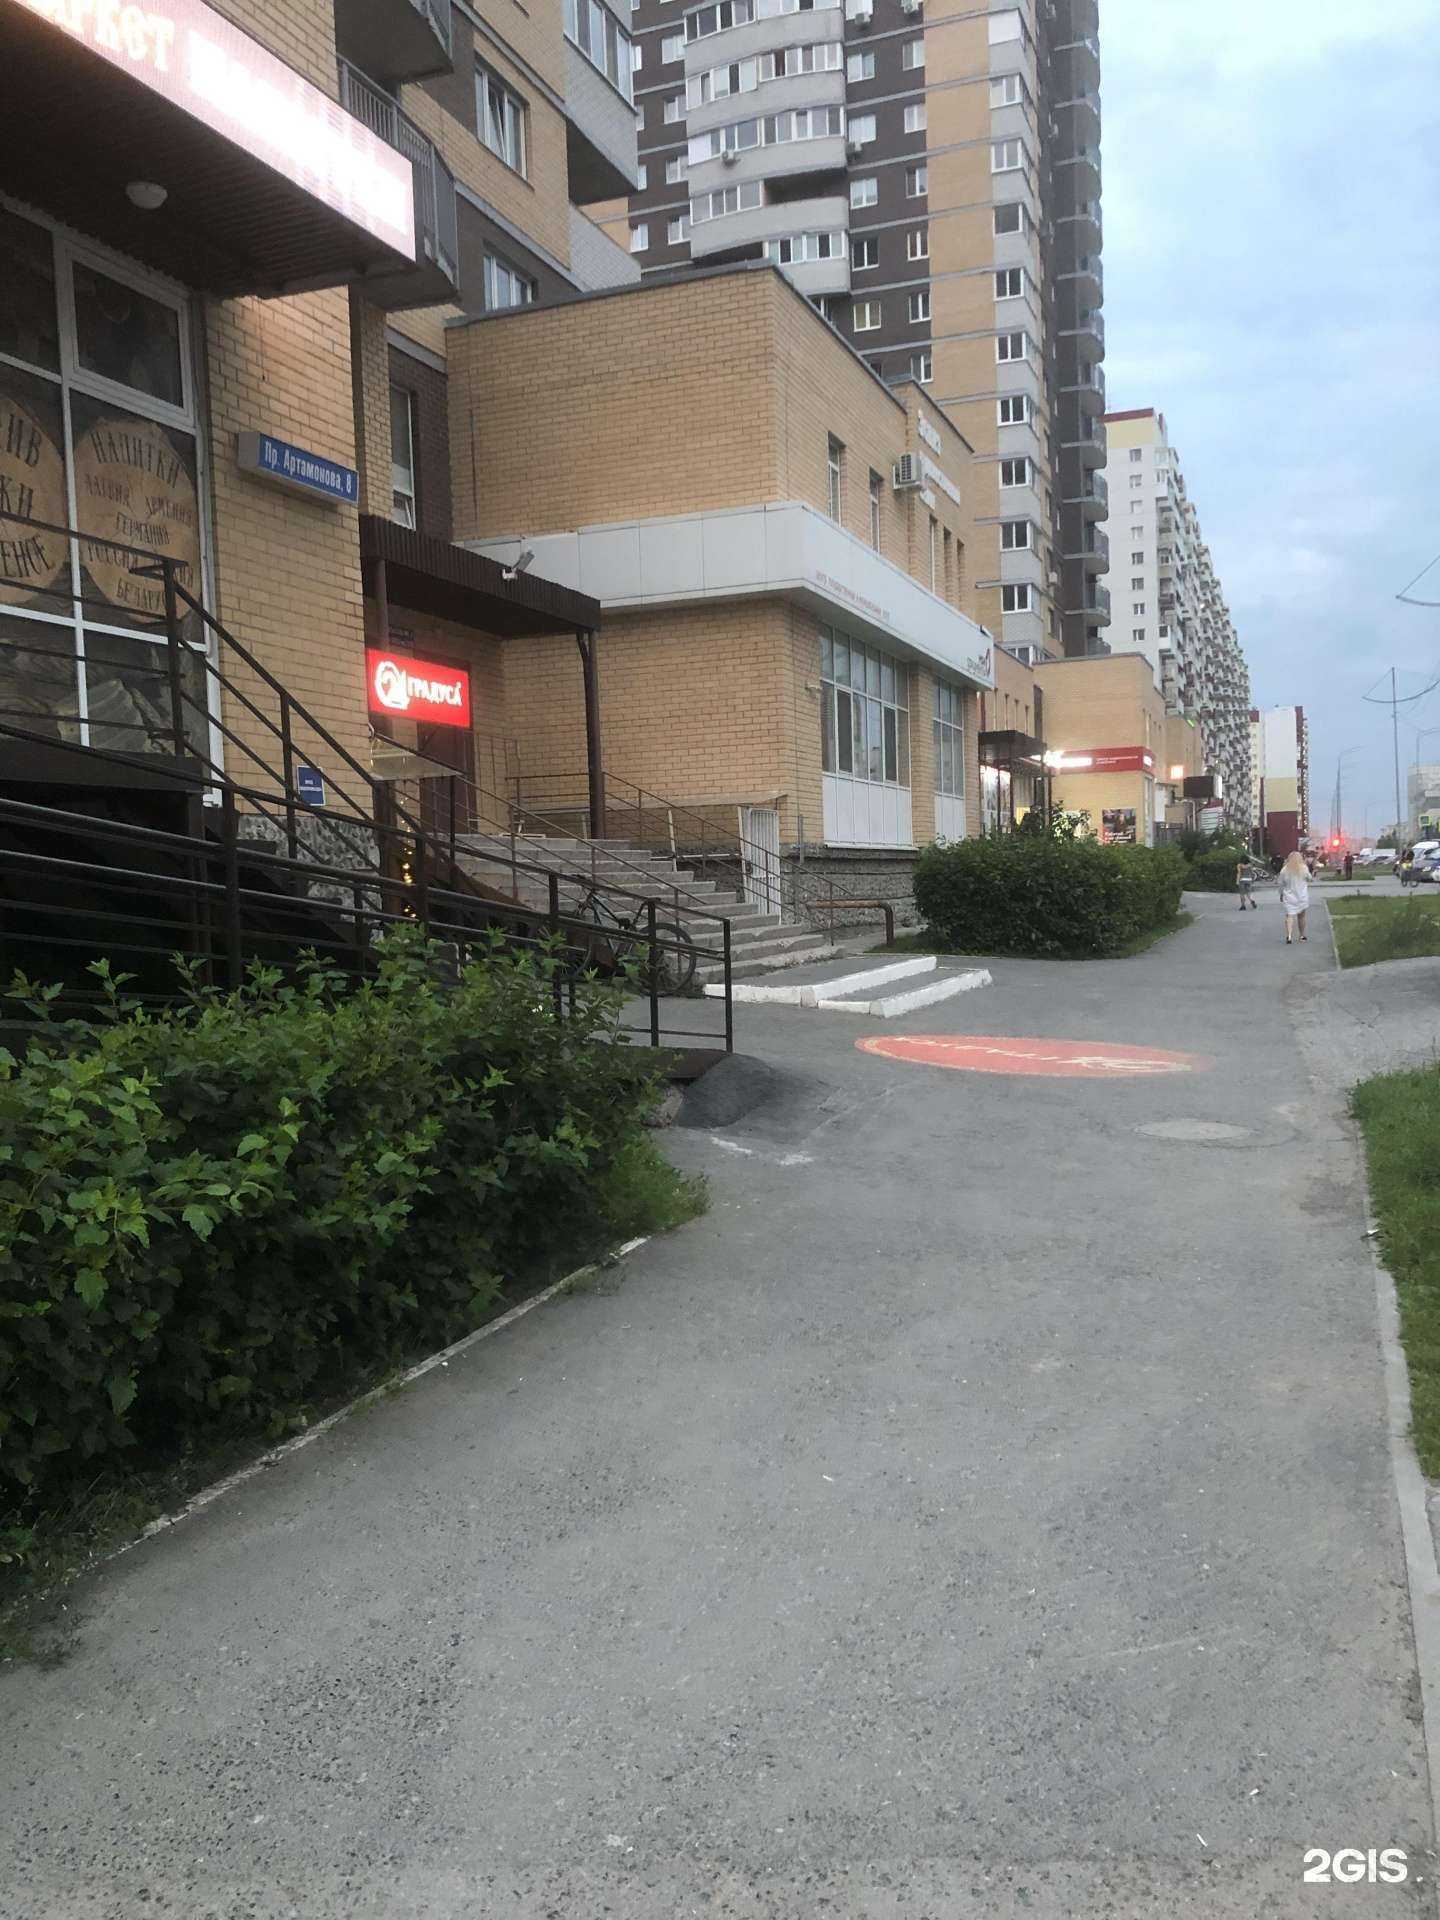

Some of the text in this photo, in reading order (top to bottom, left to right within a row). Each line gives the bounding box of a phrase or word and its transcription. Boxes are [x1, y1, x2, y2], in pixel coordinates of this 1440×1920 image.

[90, 431, 181, 488] НАПИТКИ
[265, 440, 280, 469] Пр.
[346, 473, 352, 494] 8
